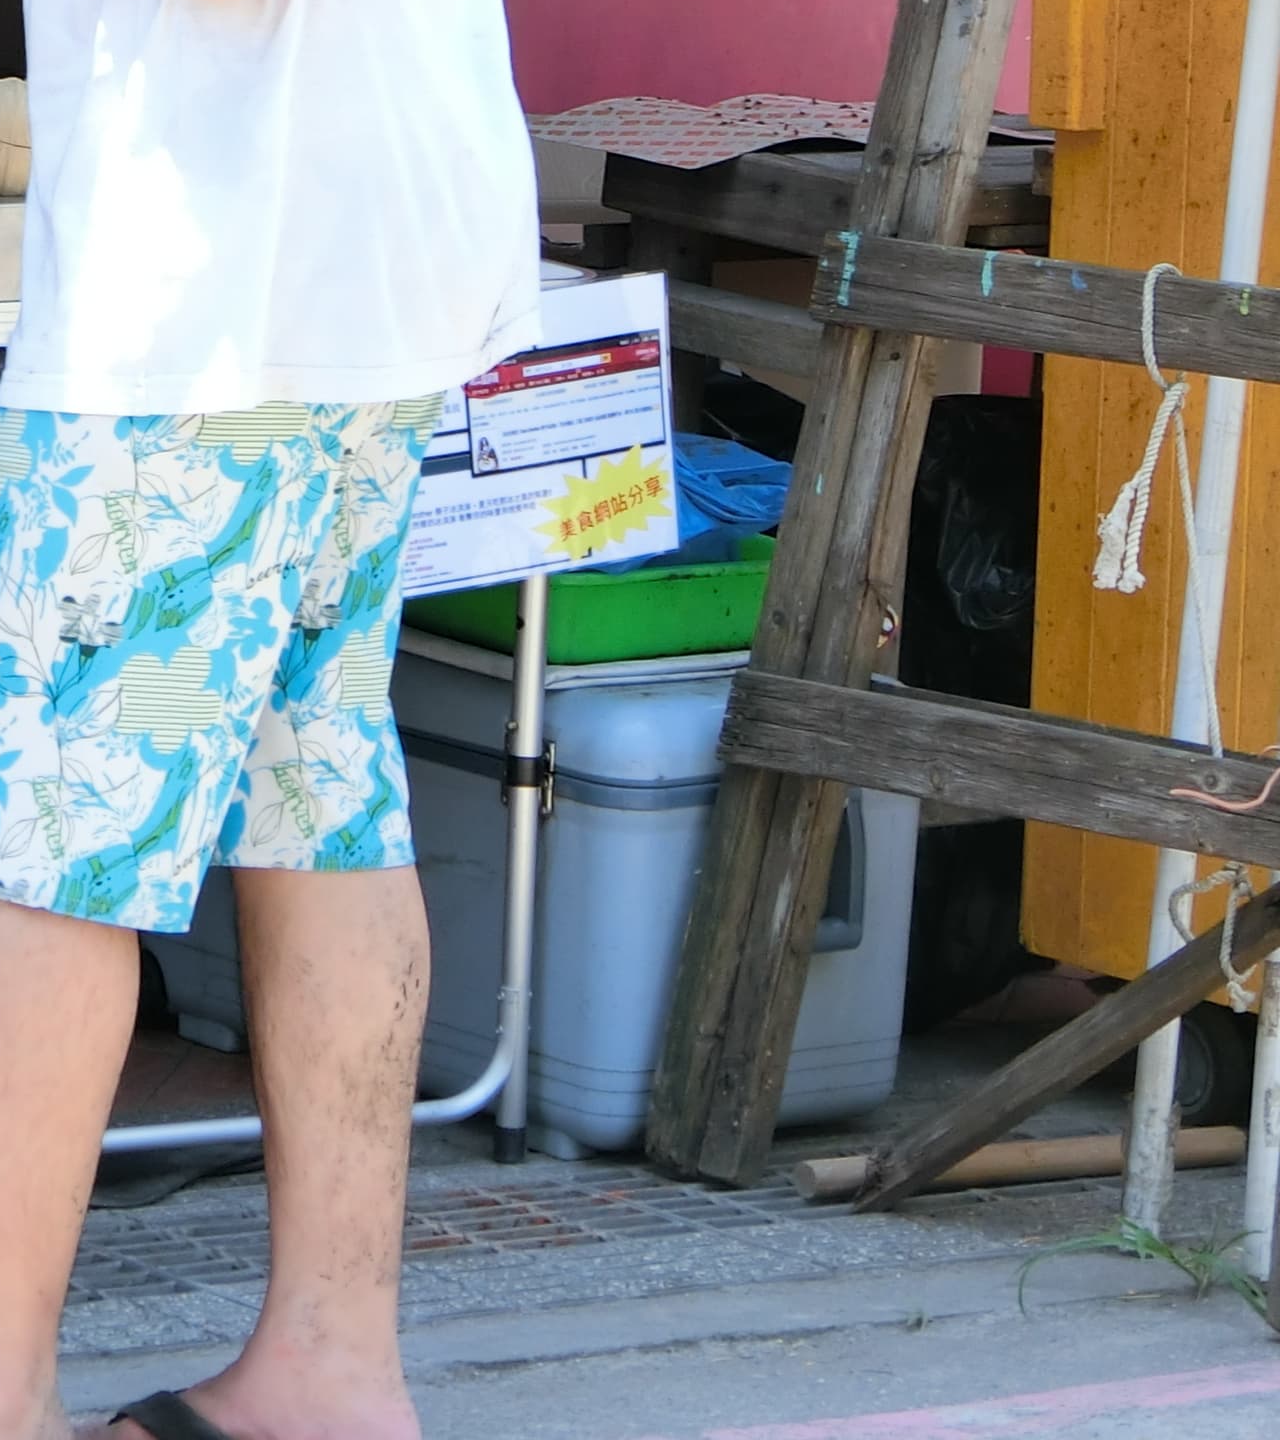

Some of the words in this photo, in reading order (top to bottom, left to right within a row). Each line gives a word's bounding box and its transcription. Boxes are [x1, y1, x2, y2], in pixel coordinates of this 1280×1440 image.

[560, 475, 663, 541] 美食網站分享
